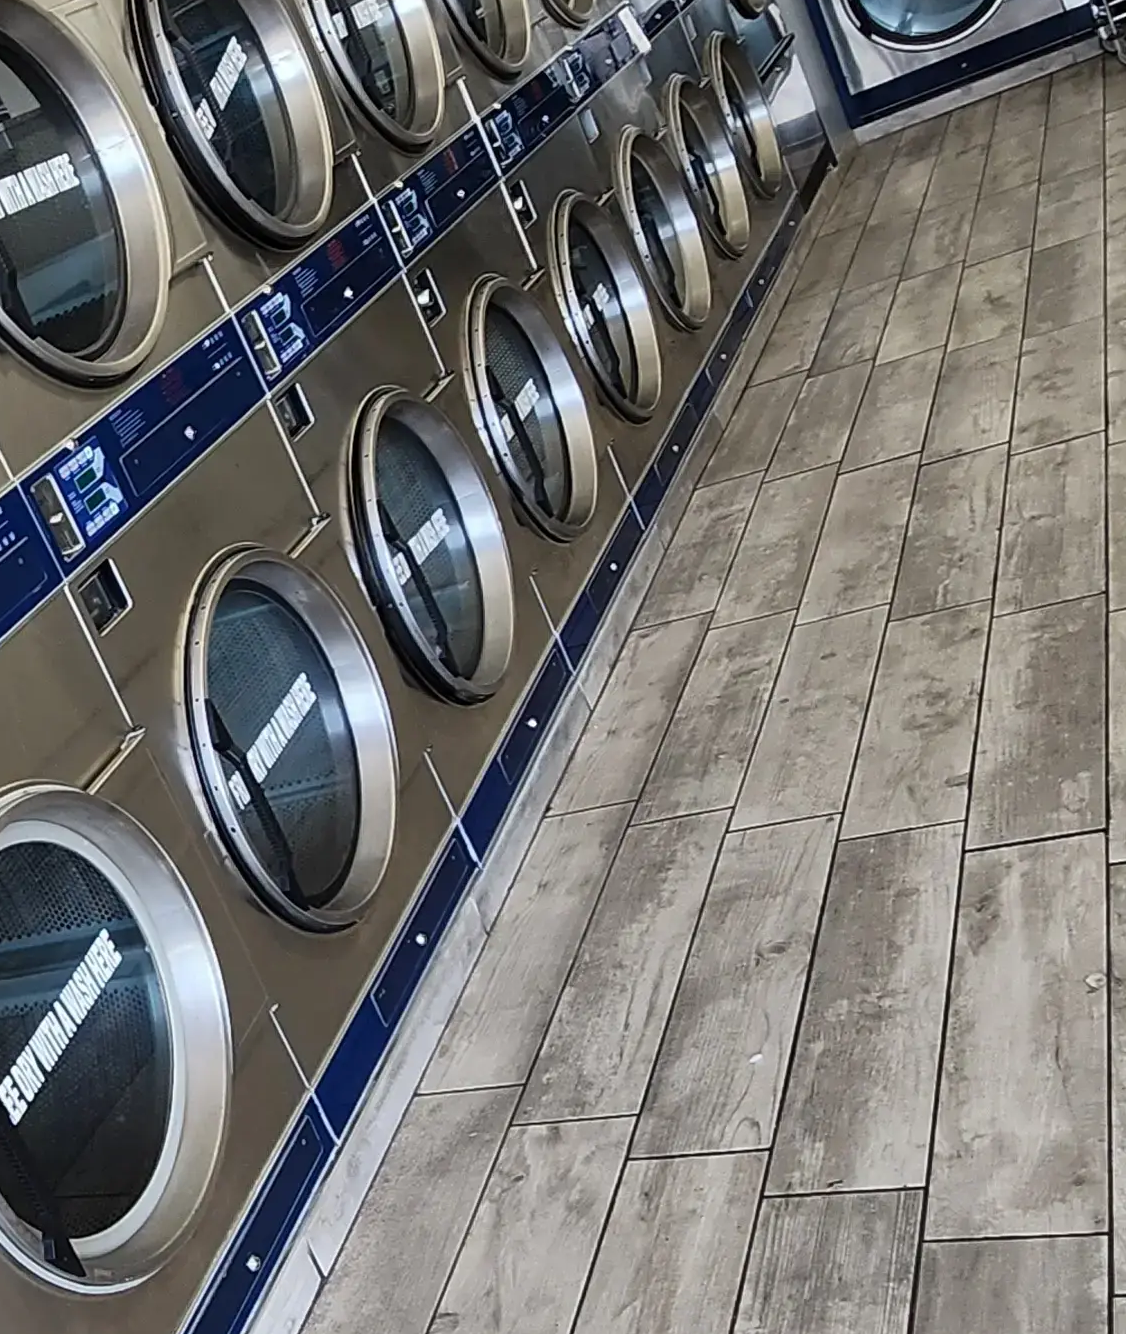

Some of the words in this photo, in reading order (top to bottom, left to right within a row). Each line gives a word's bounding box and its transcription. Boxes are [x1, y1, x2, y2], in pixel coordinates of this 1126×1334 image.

[84, 927, 123, 989] HERE
[52, 1000, 78, 1039] A
[59, 961, 102, 1026] WASH
[27, 1010, 70, 1073] WITH
